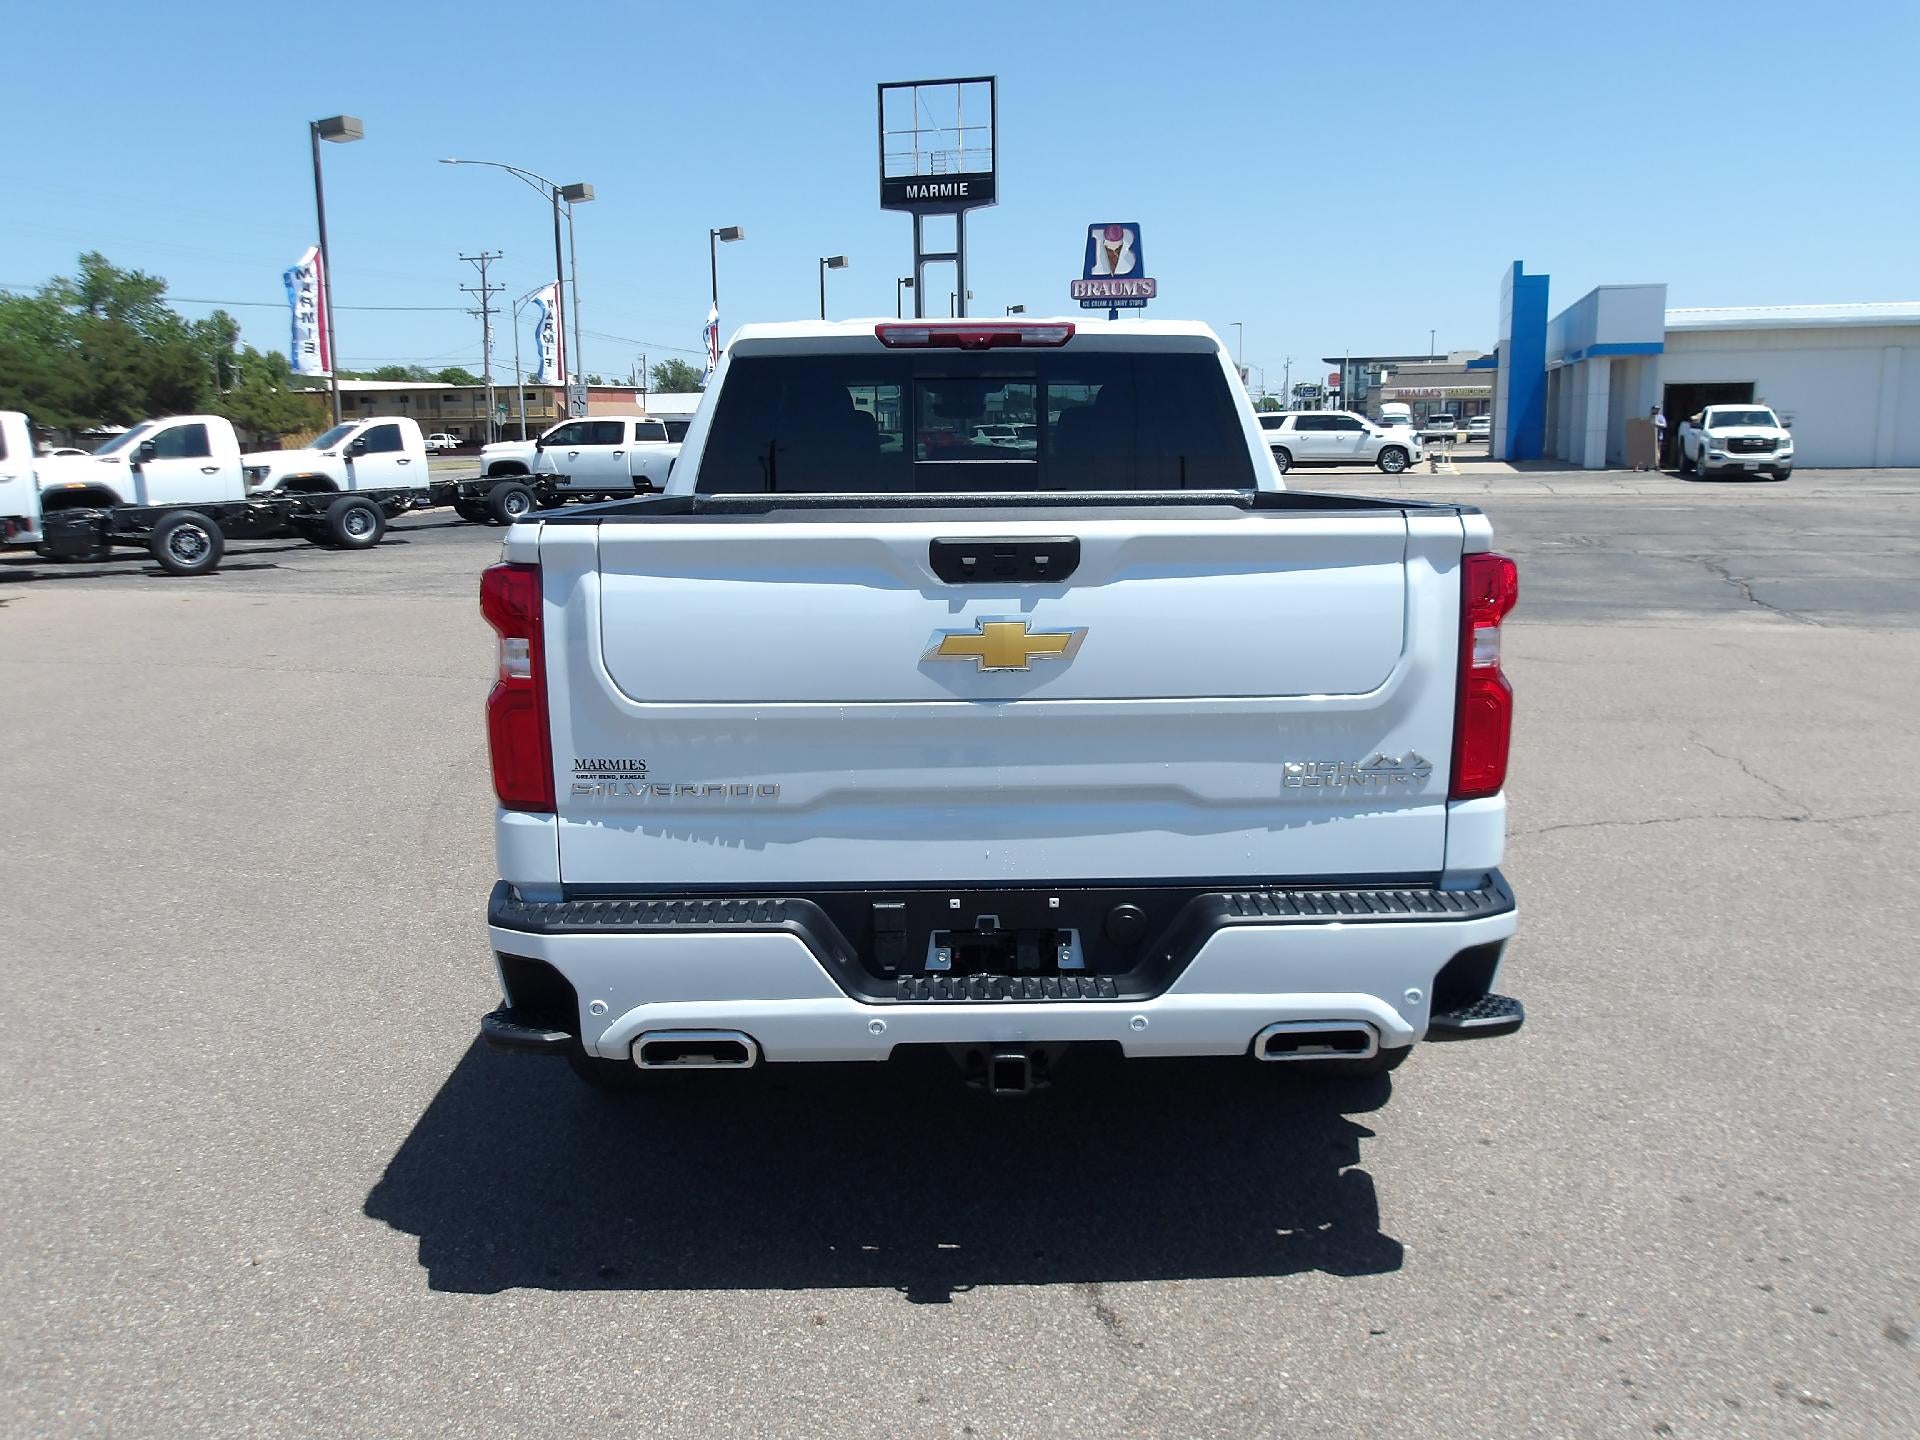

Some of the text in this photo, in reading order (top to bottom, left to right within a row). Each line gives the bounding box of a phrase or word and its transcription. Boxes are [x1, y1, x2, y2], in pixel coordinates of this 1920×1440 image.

[906, 182, 969, 199] MARMIE
[1073, 280, 1153, 297] BRAUM'S
[574, 759, 647, 771] MARMIES
[571, 783, 780, 798] SILVERADO
